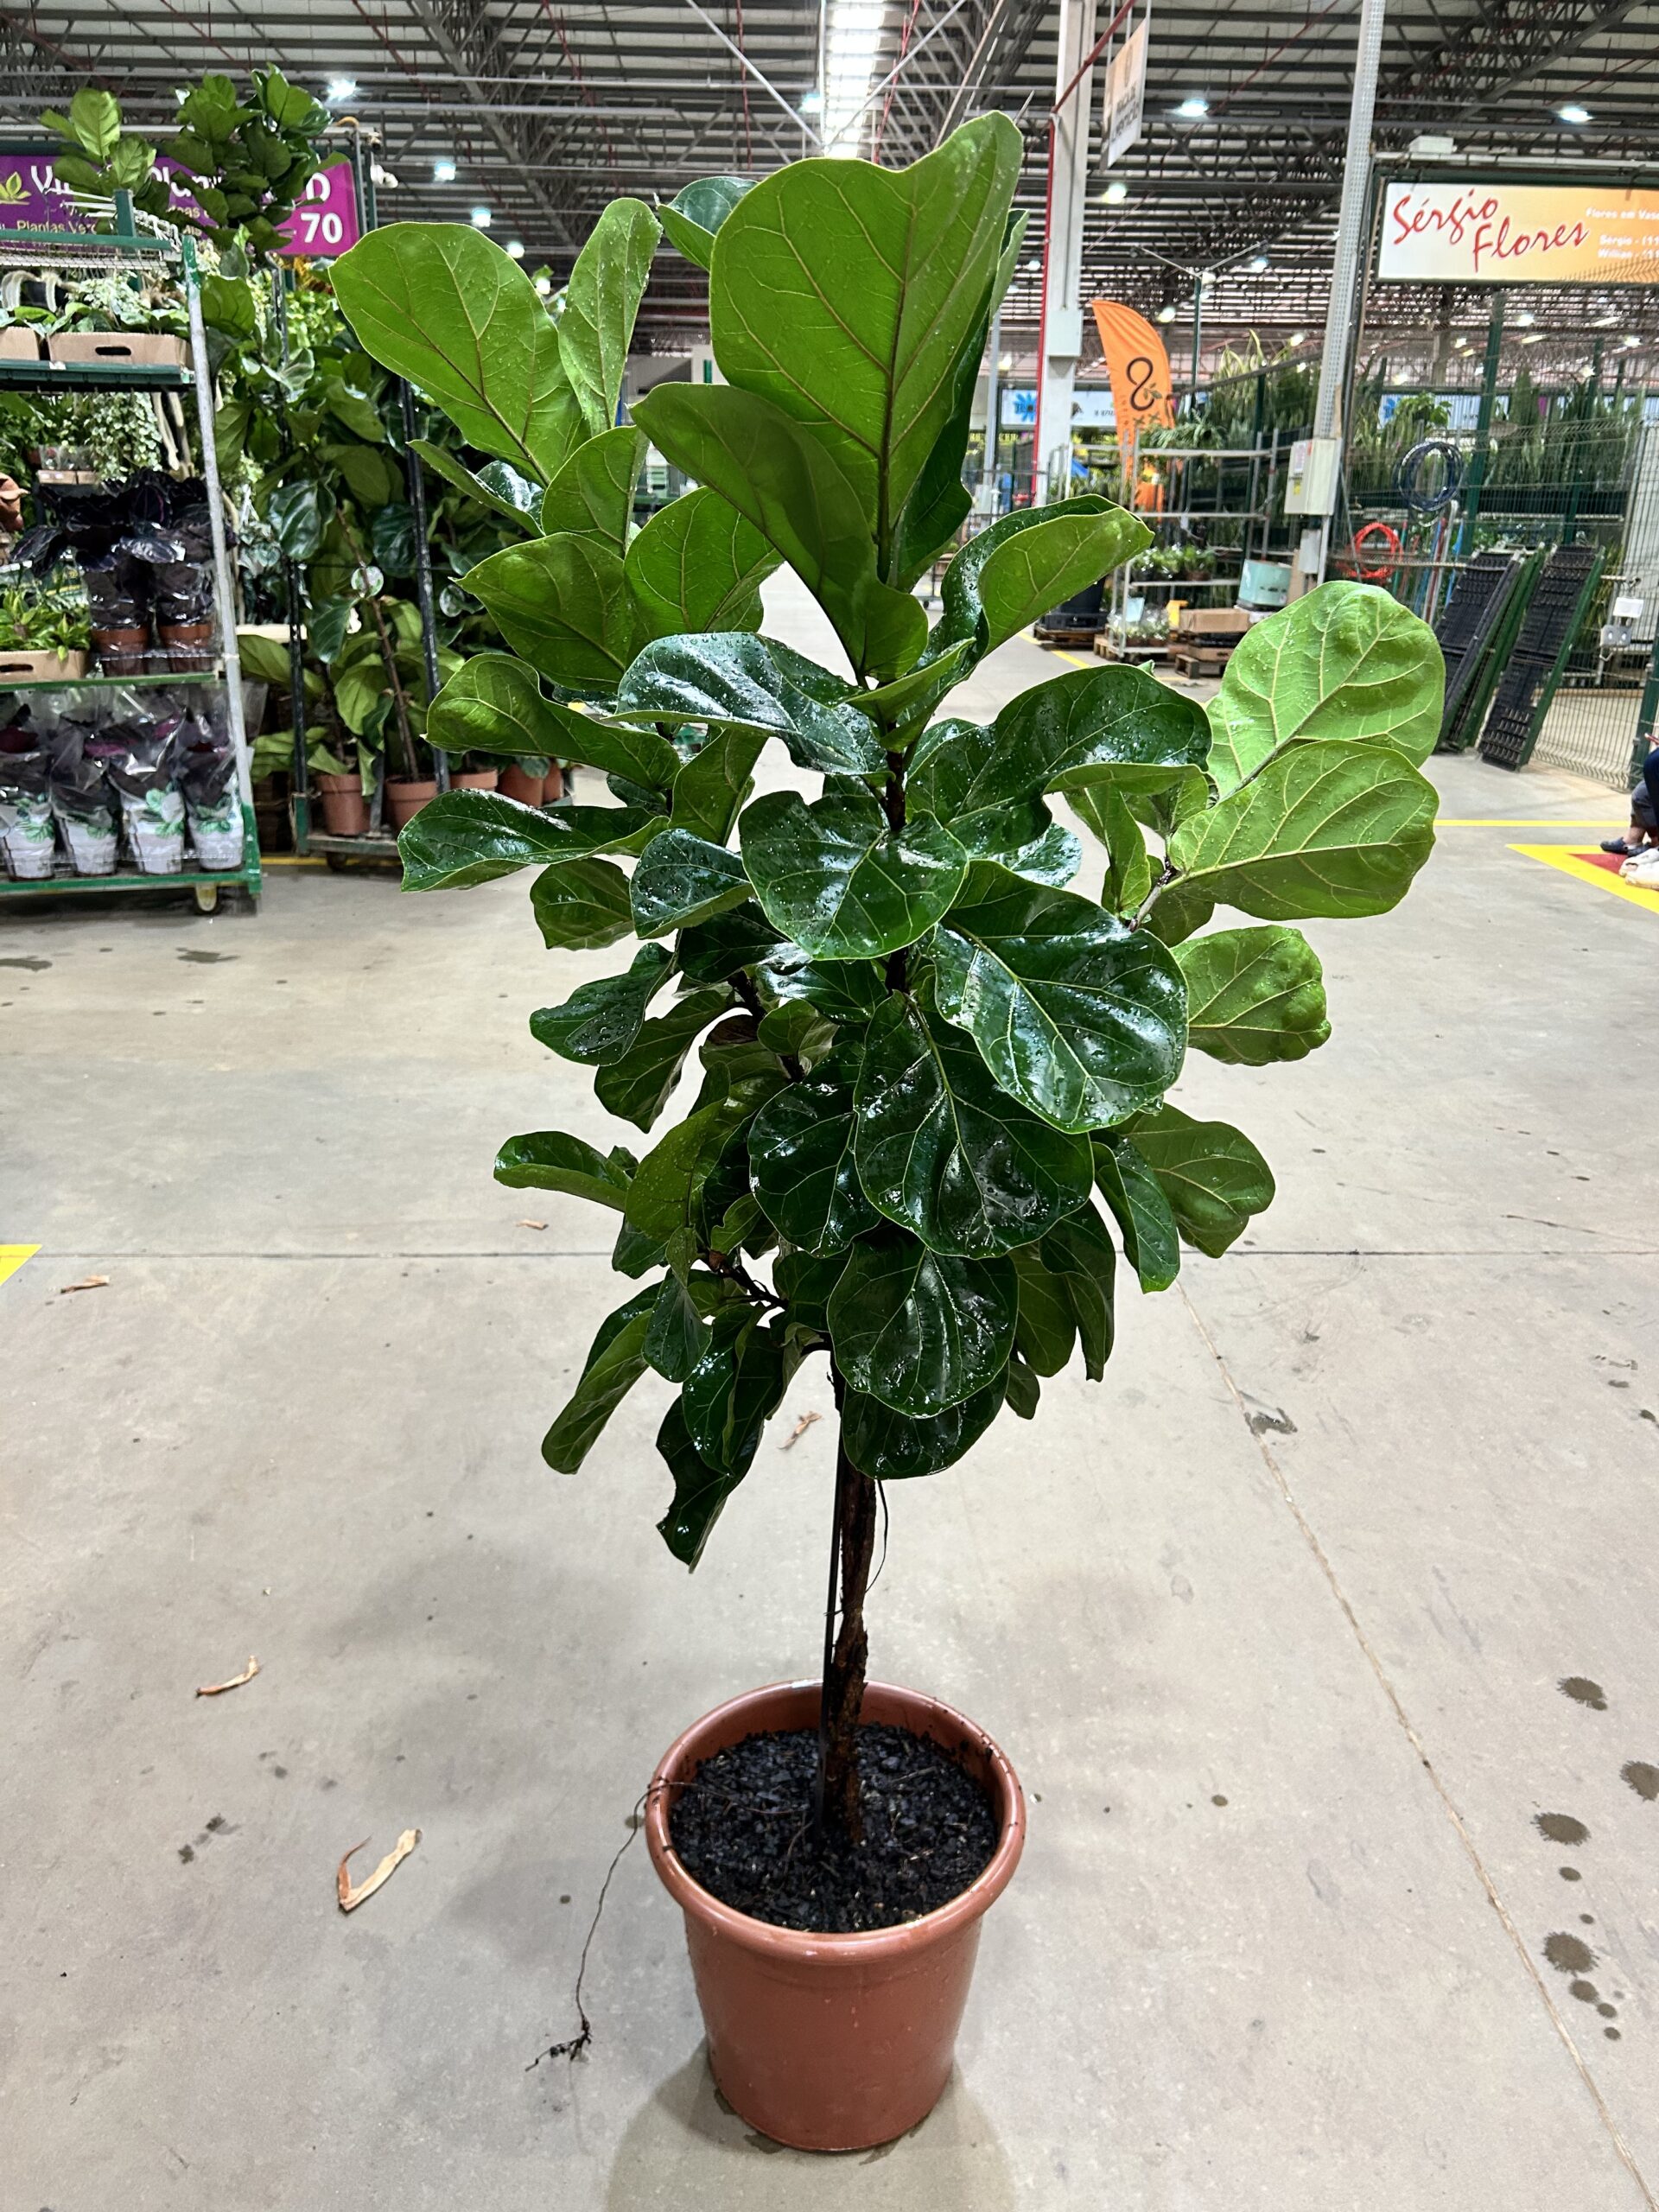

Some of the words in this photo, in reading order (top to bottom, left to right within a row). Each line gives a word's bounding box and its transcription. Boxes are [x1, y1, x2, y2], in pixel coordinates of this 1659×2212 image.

[301, 213, 343, 244] 70
[1393, 188, 1499, 245] Sérgio
[1472, 215, 1589, 273] Flores
